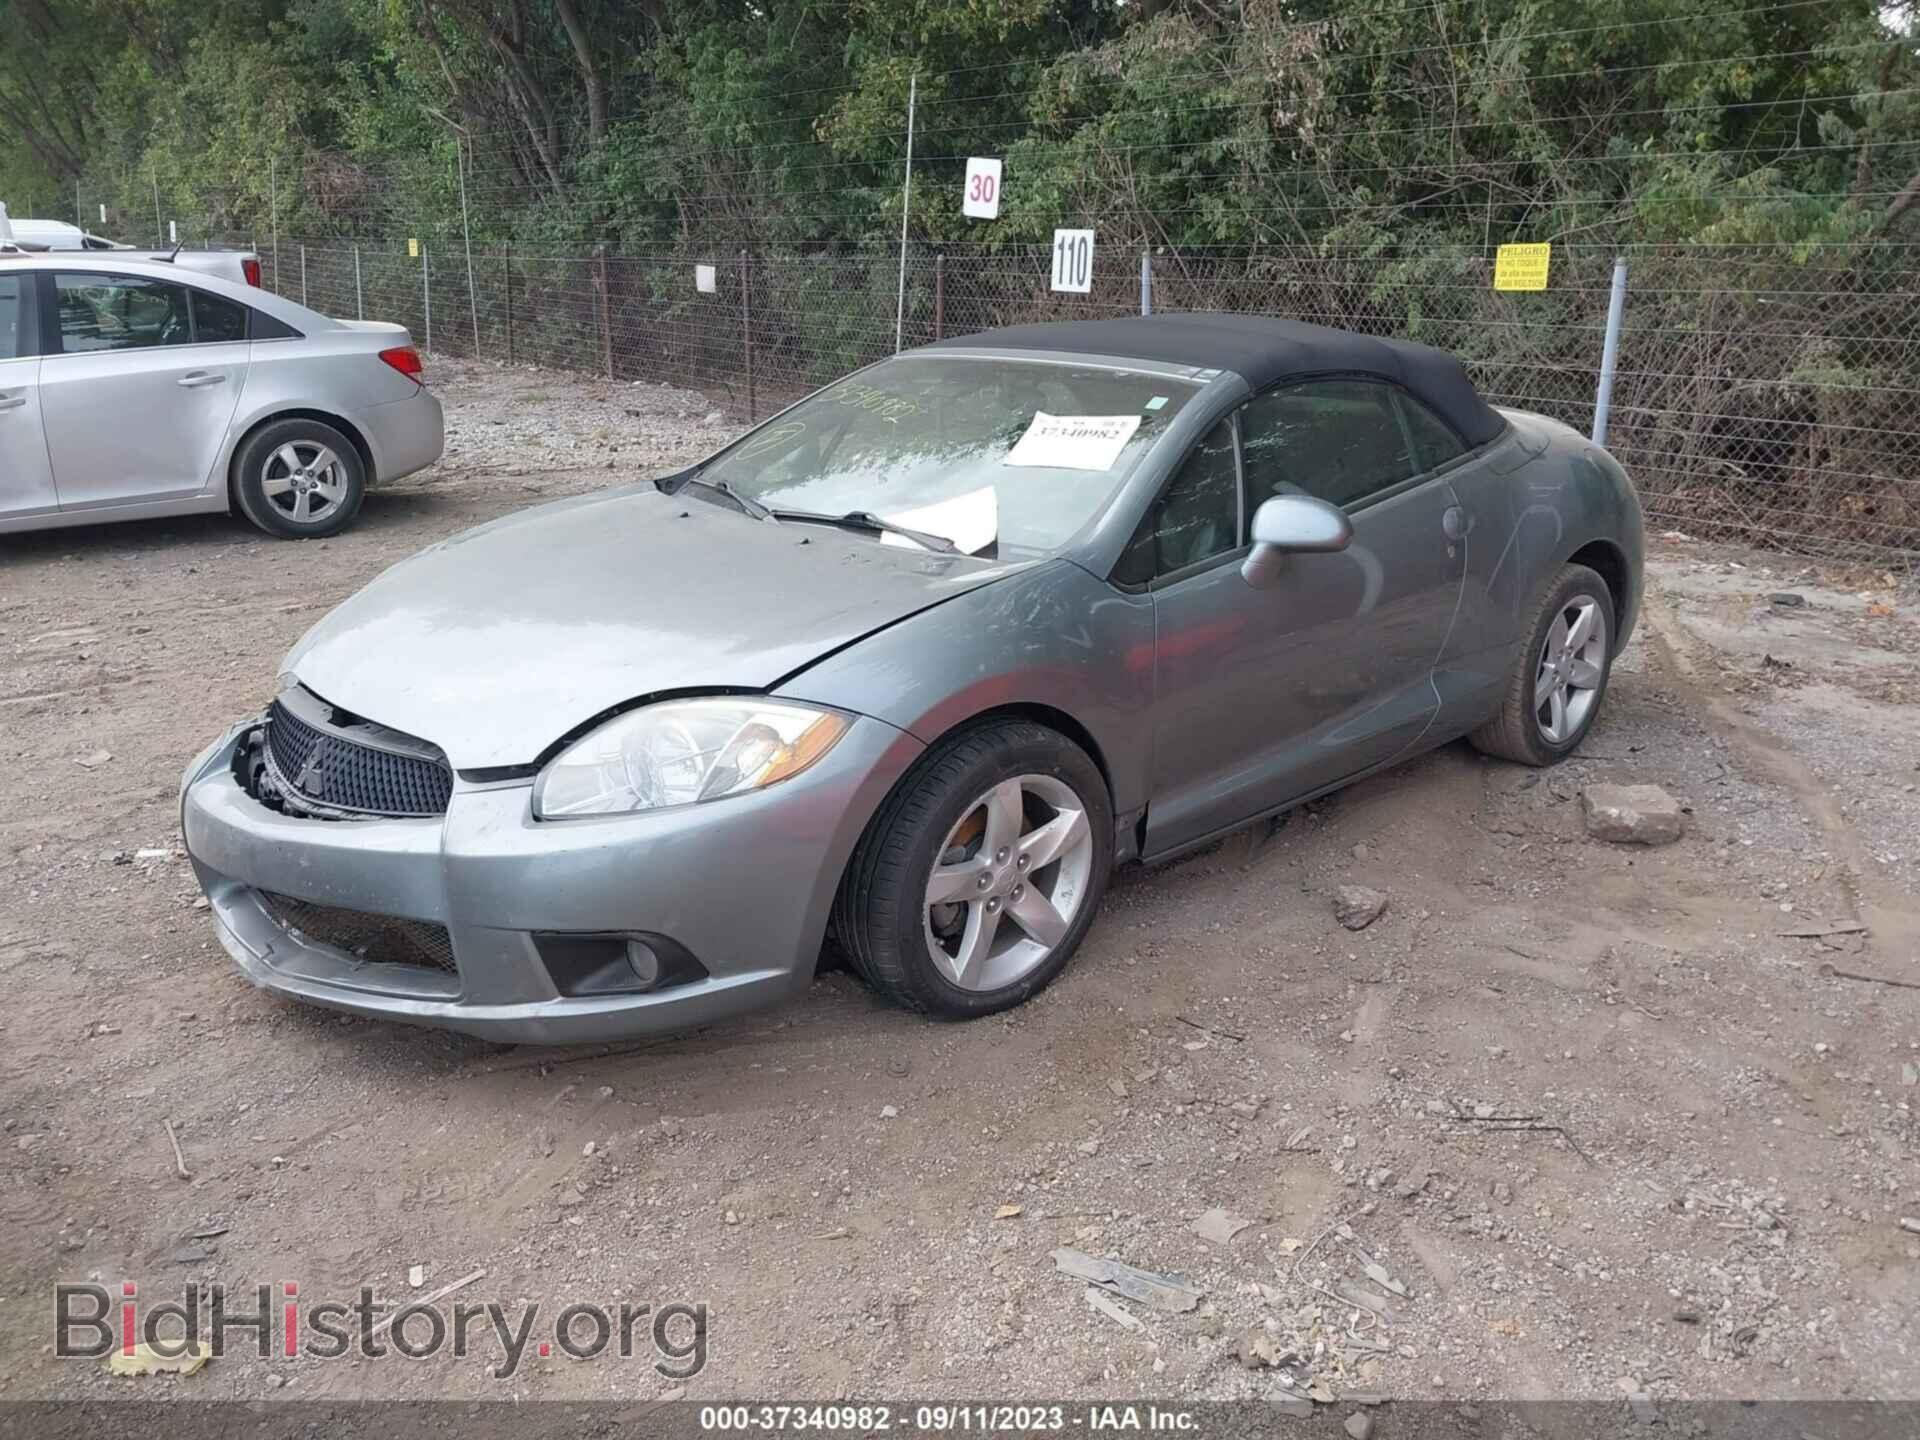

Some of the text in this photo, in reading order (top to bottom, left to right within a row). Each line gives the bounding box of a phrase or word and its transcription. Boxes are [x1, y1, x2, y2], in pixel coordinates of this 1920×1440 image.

[970, 174, 995, 203] 30
[1058, 235, 1088, 287] 110
[1500, 246, 1547, 257] PELIGRO
